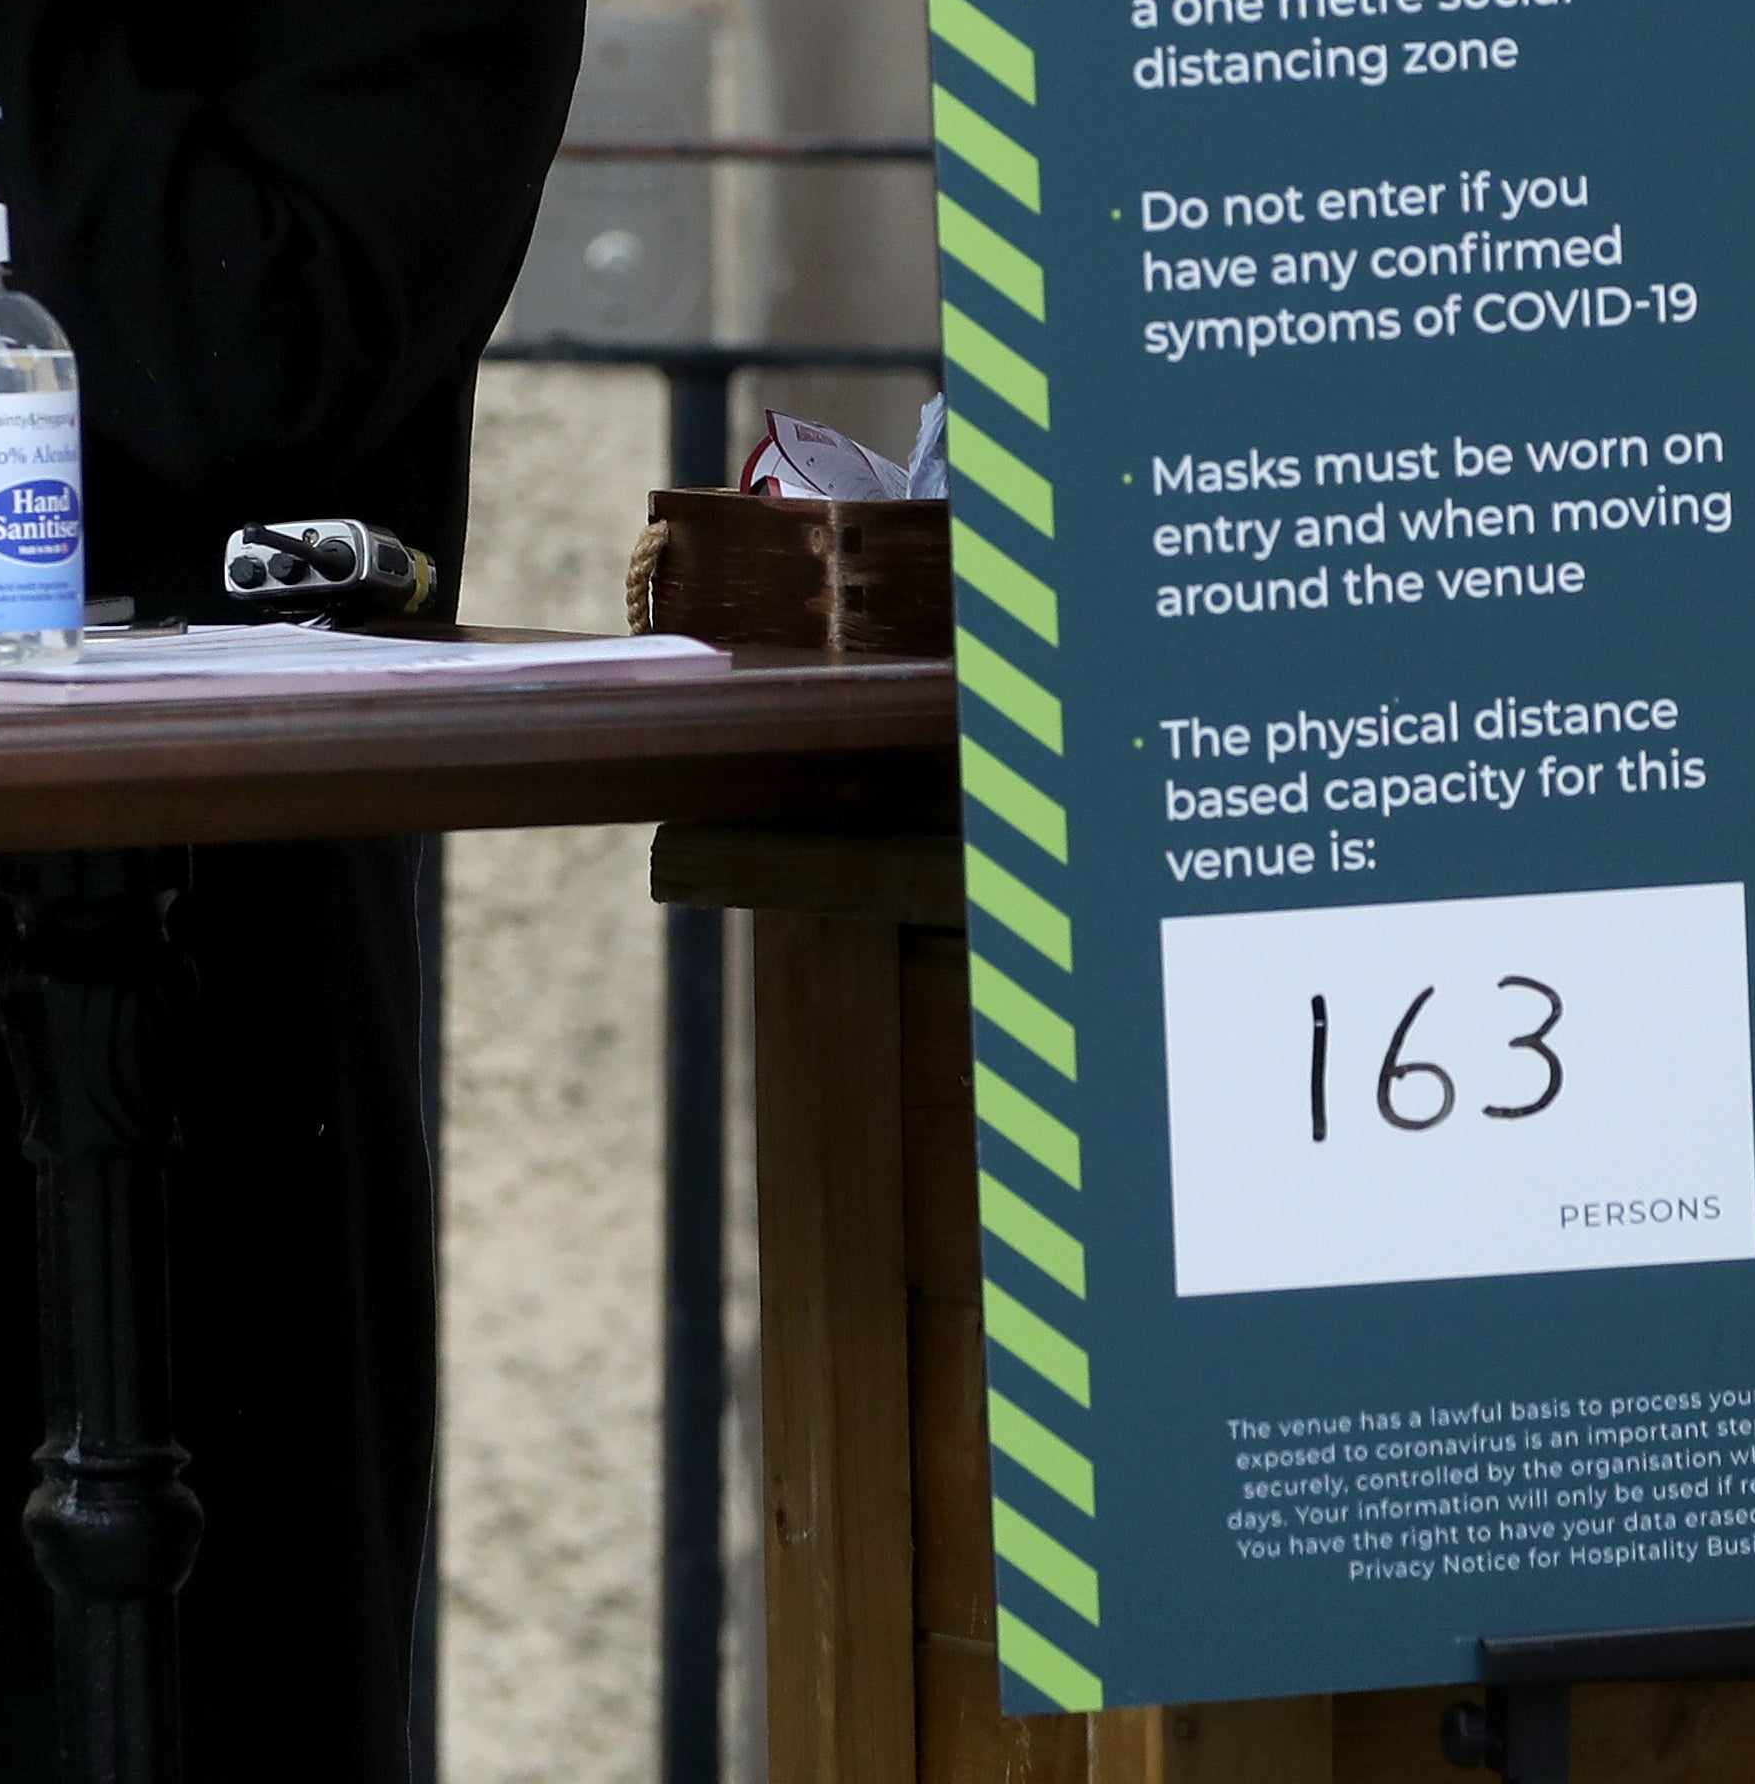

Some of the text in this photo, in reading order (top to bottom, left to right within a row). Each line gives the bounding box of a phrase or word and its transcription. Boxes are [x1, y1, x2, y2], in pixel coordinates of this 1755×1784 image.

[1133, 36, 1519, 90] distancing zone
[1141, 169, 1588, 232] Do not enter if you
[1143, 223, 1623, 293] have any confirmed
[1144, 282, 1698, 363] symptoms of COVID-19
[1152, 431, 1724, 496] Masks must be worn on
[12, 486, 71, 514] Hand
[1152, 484, 1732, 561] entry and when moving
[1156, 561, 1586, 618] around the venue
[1159, 696, 1679, 764] The physical distance
[1165, 747, 1707, 821] based capacity for this
[1165, 829, 1377, 882] venue is:
[1310, 975, 1563, 1143] 163
[1559, 1194, 1722, 1230] PERSONS
[1227, 1419, 1271, 1441] The
[1278, 1416, 1352, 1437] venue
[1359, 1410, 1402, 1431] has
[1409, 1410, 1422, 1429] a
[1430, 1401, 1502, 1427] lawful
[1510, 1398, 1571, 1421] basis
[1578, 1398, 1603, 1417] to
[1610, 1392, 1702, 1418] process
[1236, 1443, 1336, 1473] exposed
[1343, 1444, 1368, 1463] to
[1376, 1432, 1517, 1461] coronavirus
[1524, 1430, 1543, 1450] is
[1550, 1430, 1579, 1448] an
[1588, 1420, 1709, 1448] important
[1349, 1559, 1435, 1582] Privacy
[1443, 1551, 1521, 1575] Notice
[1528, 1547, 1561, 1569] for
[1569, 1538, 1699, 1568] Hospitality
